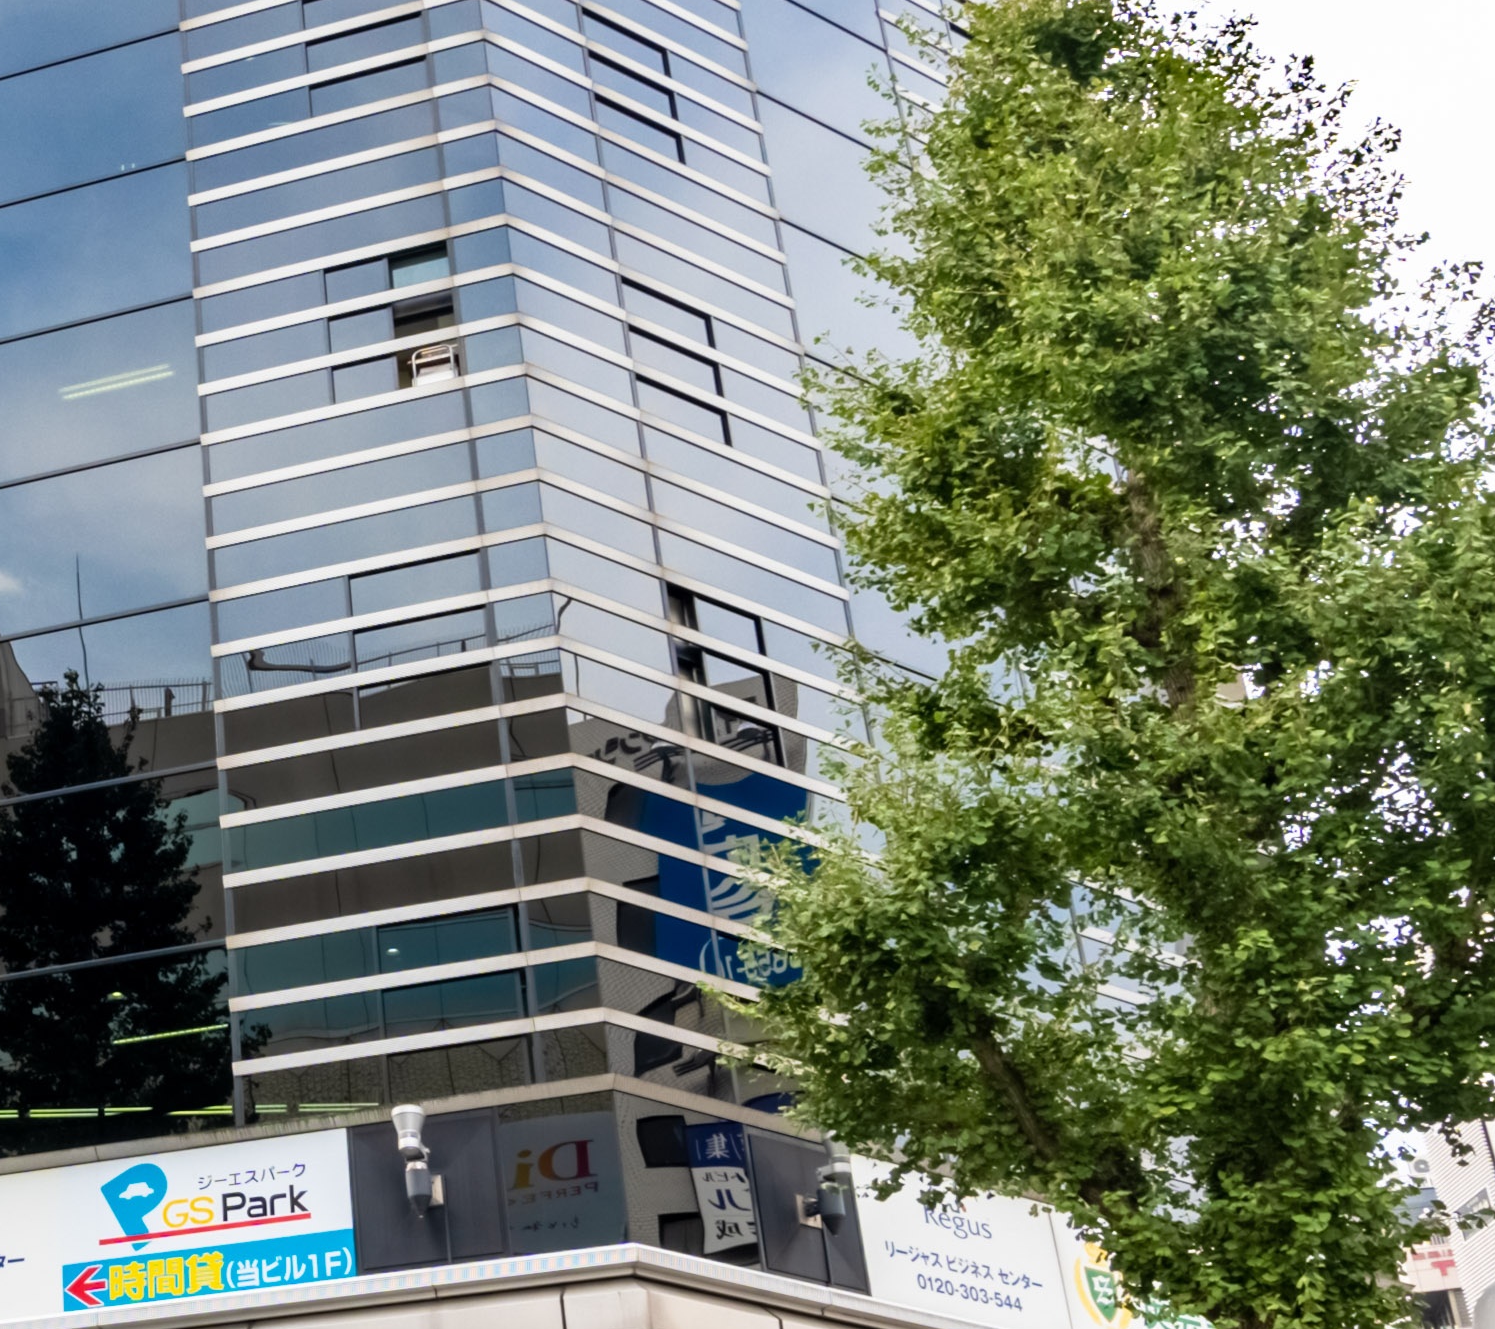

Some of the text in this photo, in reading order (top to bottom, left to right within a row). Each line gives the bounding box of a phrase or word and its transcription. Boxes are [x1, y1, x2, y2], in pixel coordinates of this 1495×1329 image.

[197, 1161, 308, 1191] ジーエスパーク
[161, 1184, 310, 1229] GS Park
[923, 1204, 993, 1239] Regus
[108, 1251, 226, 1302] 時間貸
[884, 1241, 1043, 1290] リージャス ビジネス センター
[917, 1274, 1023, 1312] 0120-303-544
